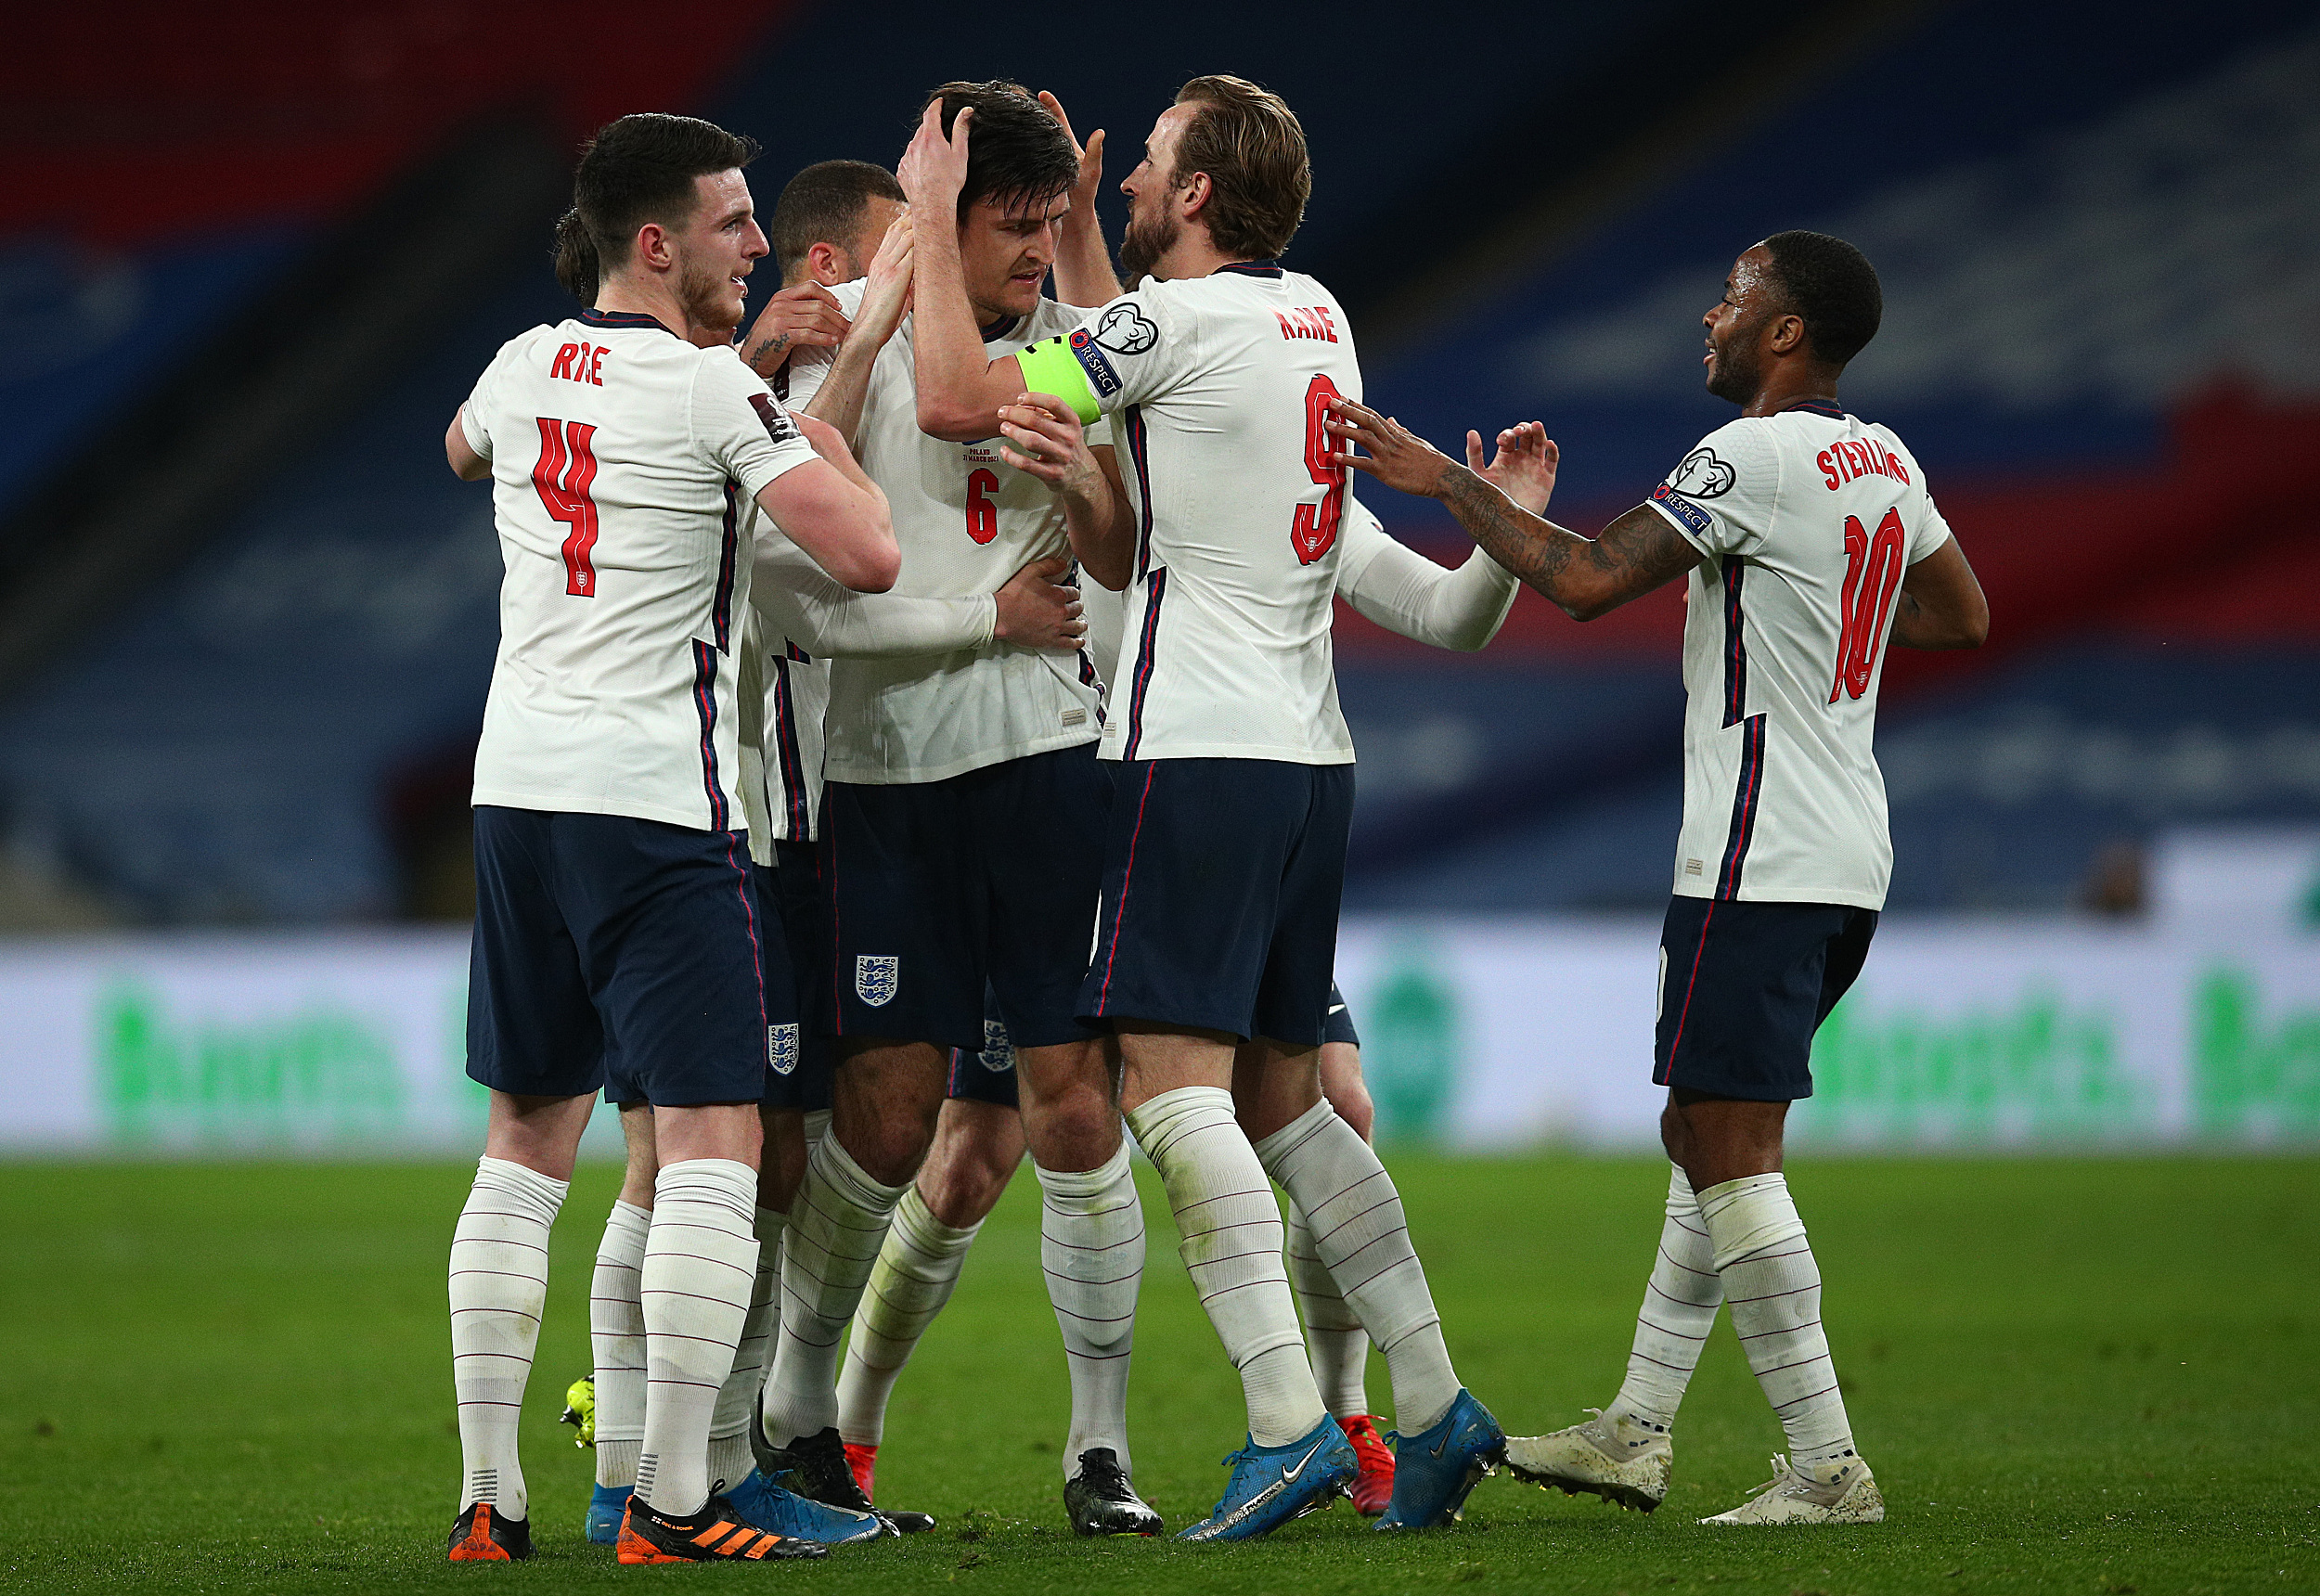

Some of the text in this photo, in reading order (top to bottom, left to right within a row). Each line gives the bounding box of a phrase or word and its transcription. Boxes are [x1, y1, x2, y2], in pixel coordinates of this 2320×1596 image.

[1080, 345, 1117, 393] RESPECT
[968, 455, 987, 463] MARCH
[1290, 373, 1347, 566] 9
[531, 416, 598, 598] 4
[965, 467, 999, 546] 6
[1664, 493, 1708, 530] RESPECT
[1828, 506, 1905, 705] 10
